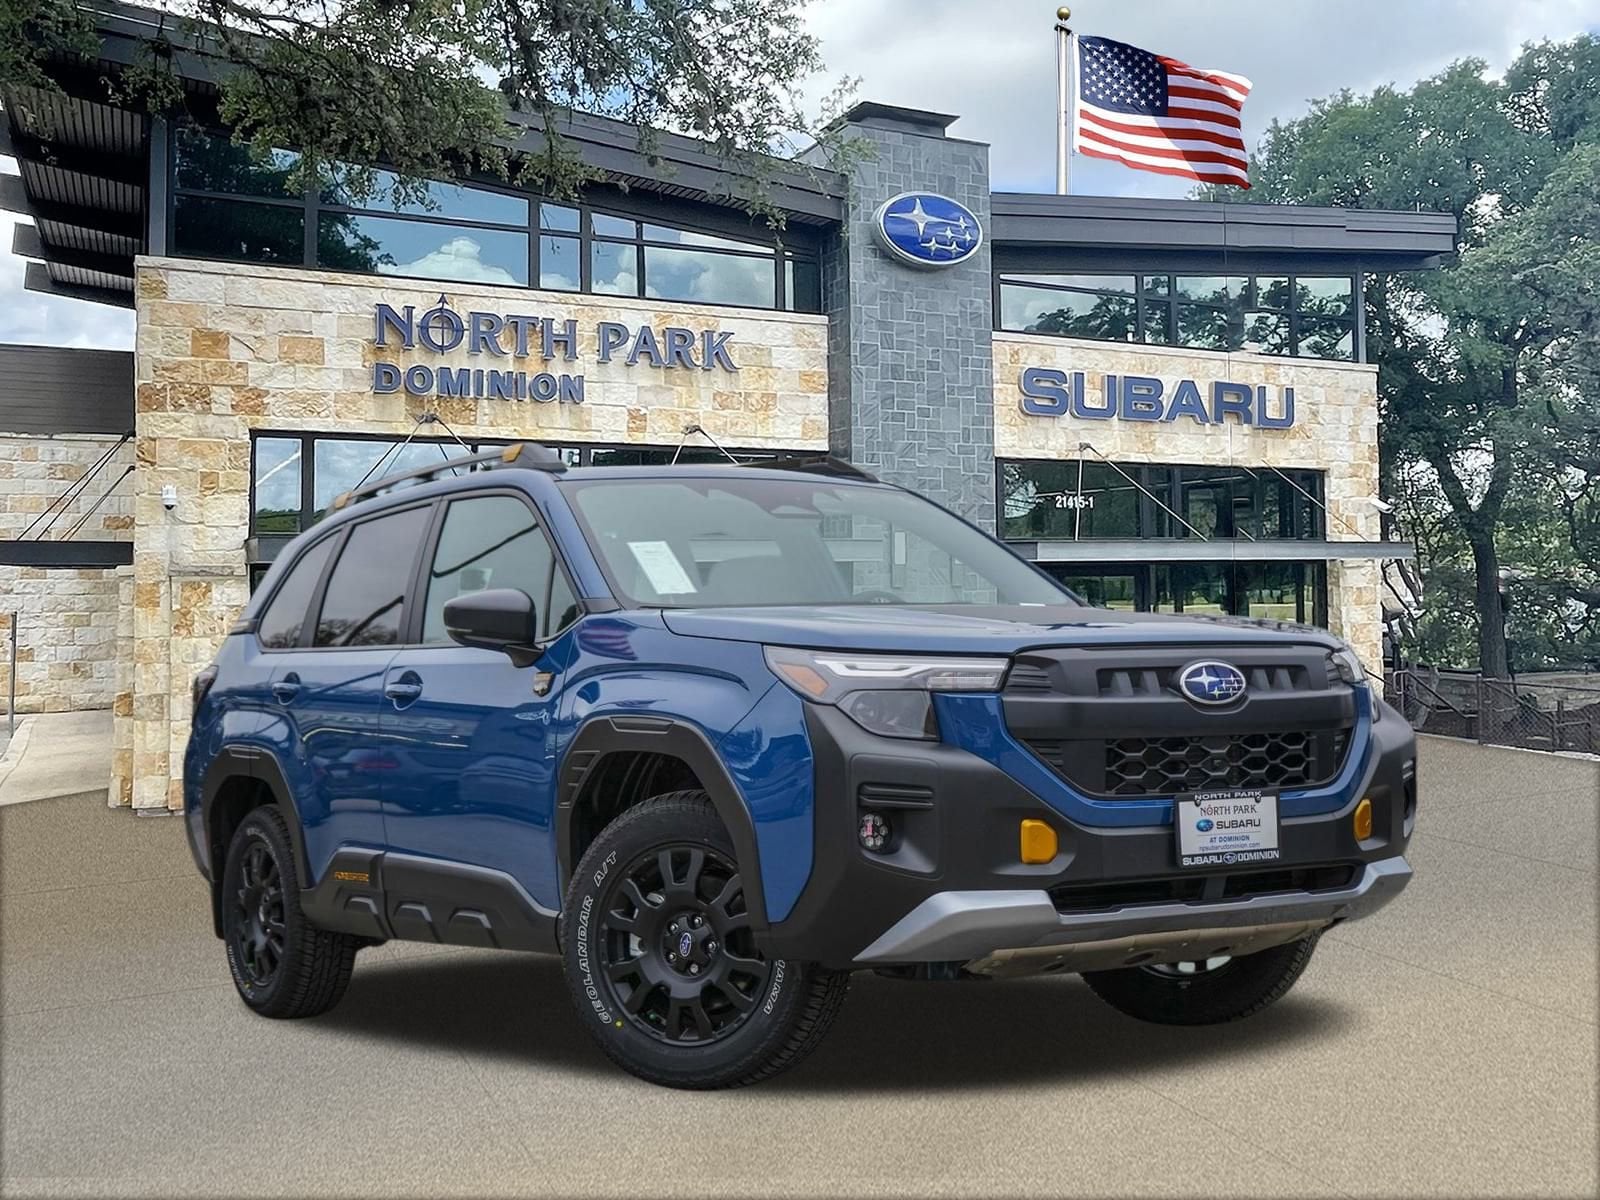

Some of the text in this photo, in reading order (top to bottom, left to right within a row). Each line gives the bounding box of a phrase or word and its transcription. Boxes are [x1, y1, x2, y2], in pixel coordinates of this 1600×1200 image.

[375, 293, 741, 373] NORTH PARK
[373, 361, 585, 404] DOMINION
[1019, 367, 1295, 430] SUBARU
[1194, 790, 1262, 801] NORTH PARK
[1200, 804, 1258, 816] NORTH PARK
[1216, 818, 1261, 829] SUBARU
[1218, 834, 1250, 843] DOMINION
[1182, 850, 1280, 866] SUBARU DOMINION
[577, 850, 617, 1024] GEOLANDAR A/T
